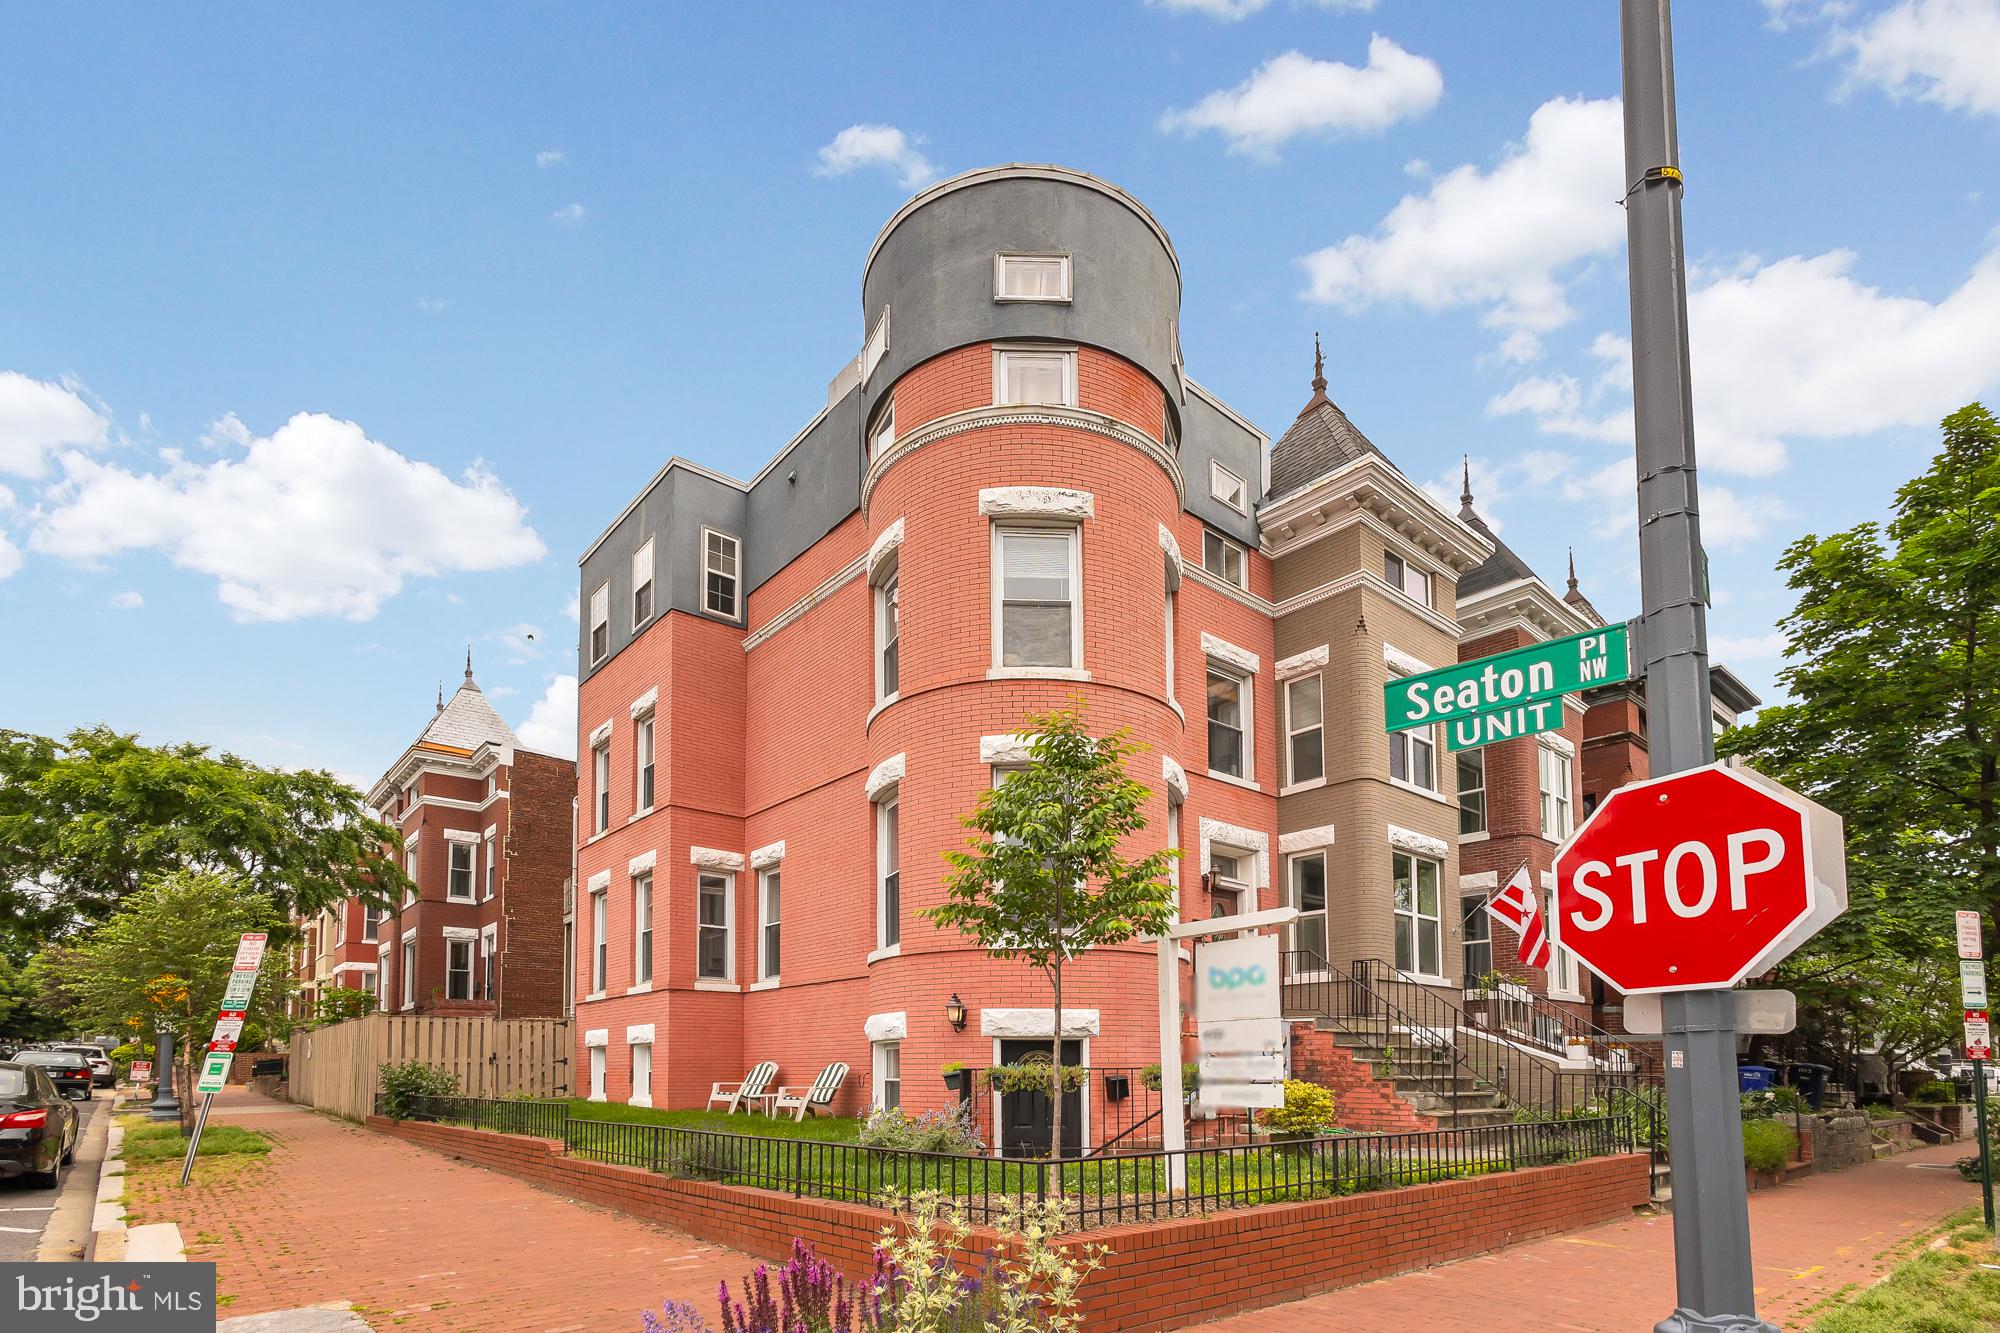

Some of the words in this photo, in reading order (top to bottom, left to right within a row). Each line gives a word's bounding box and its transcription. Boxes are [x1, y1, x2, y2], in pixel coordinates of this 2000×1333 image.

[1406, 661, 1553, 720] Seaton
[1579, 656, 1607, 682] NW
[1456, 702, 1552, 746] UNIT
[1570, 828, 1786, 932] STOP
